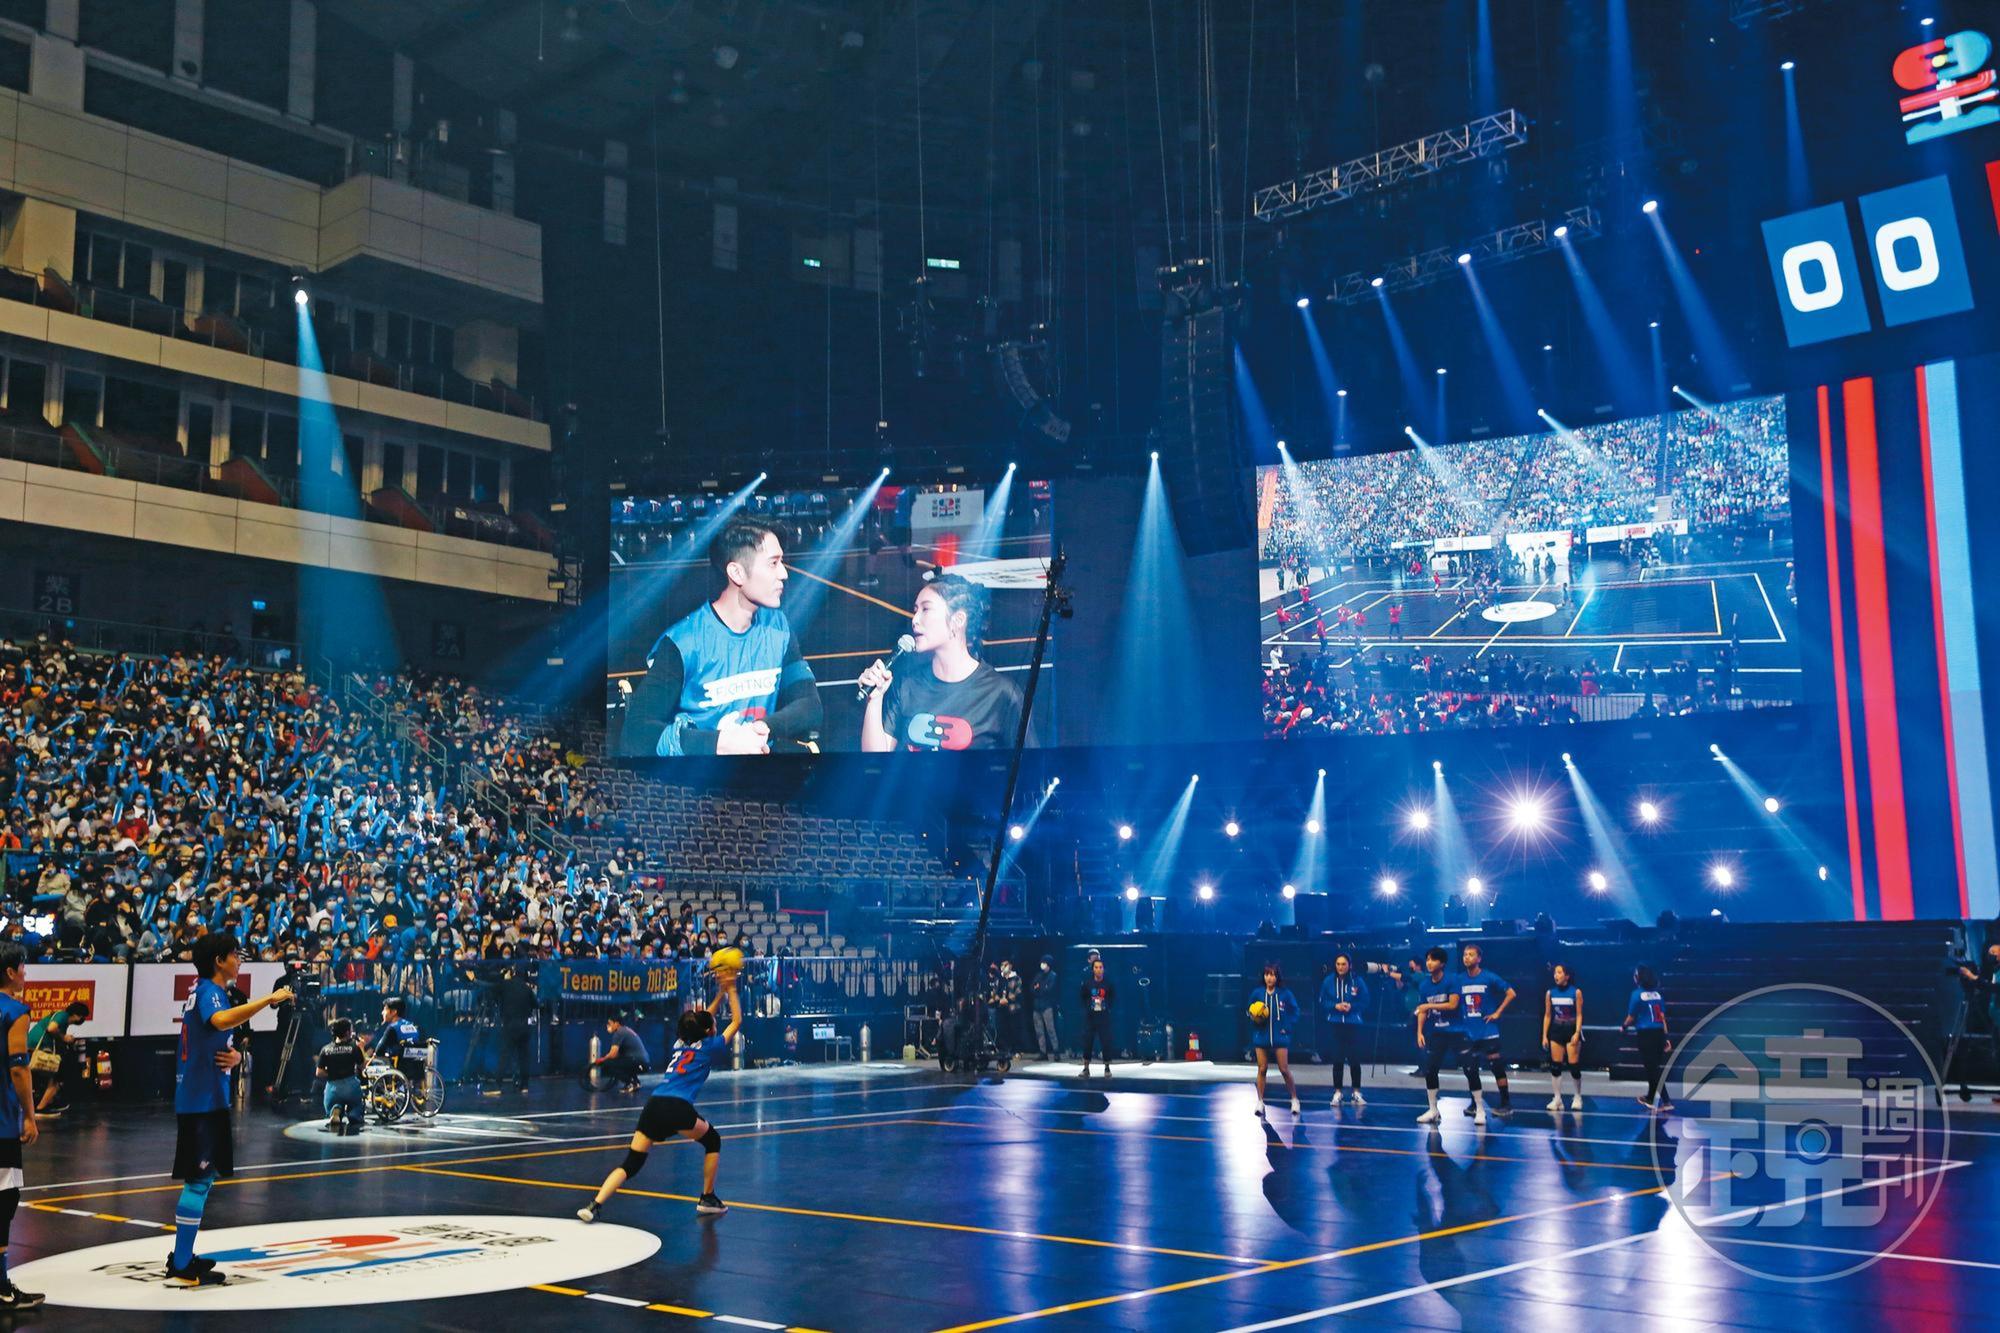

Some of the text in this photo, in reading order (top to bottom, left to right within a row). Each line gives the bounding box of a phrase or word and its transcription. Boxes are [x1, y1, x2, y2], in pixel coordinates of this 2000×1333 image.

[560, 965, 678, 993] Team Blue 加油
